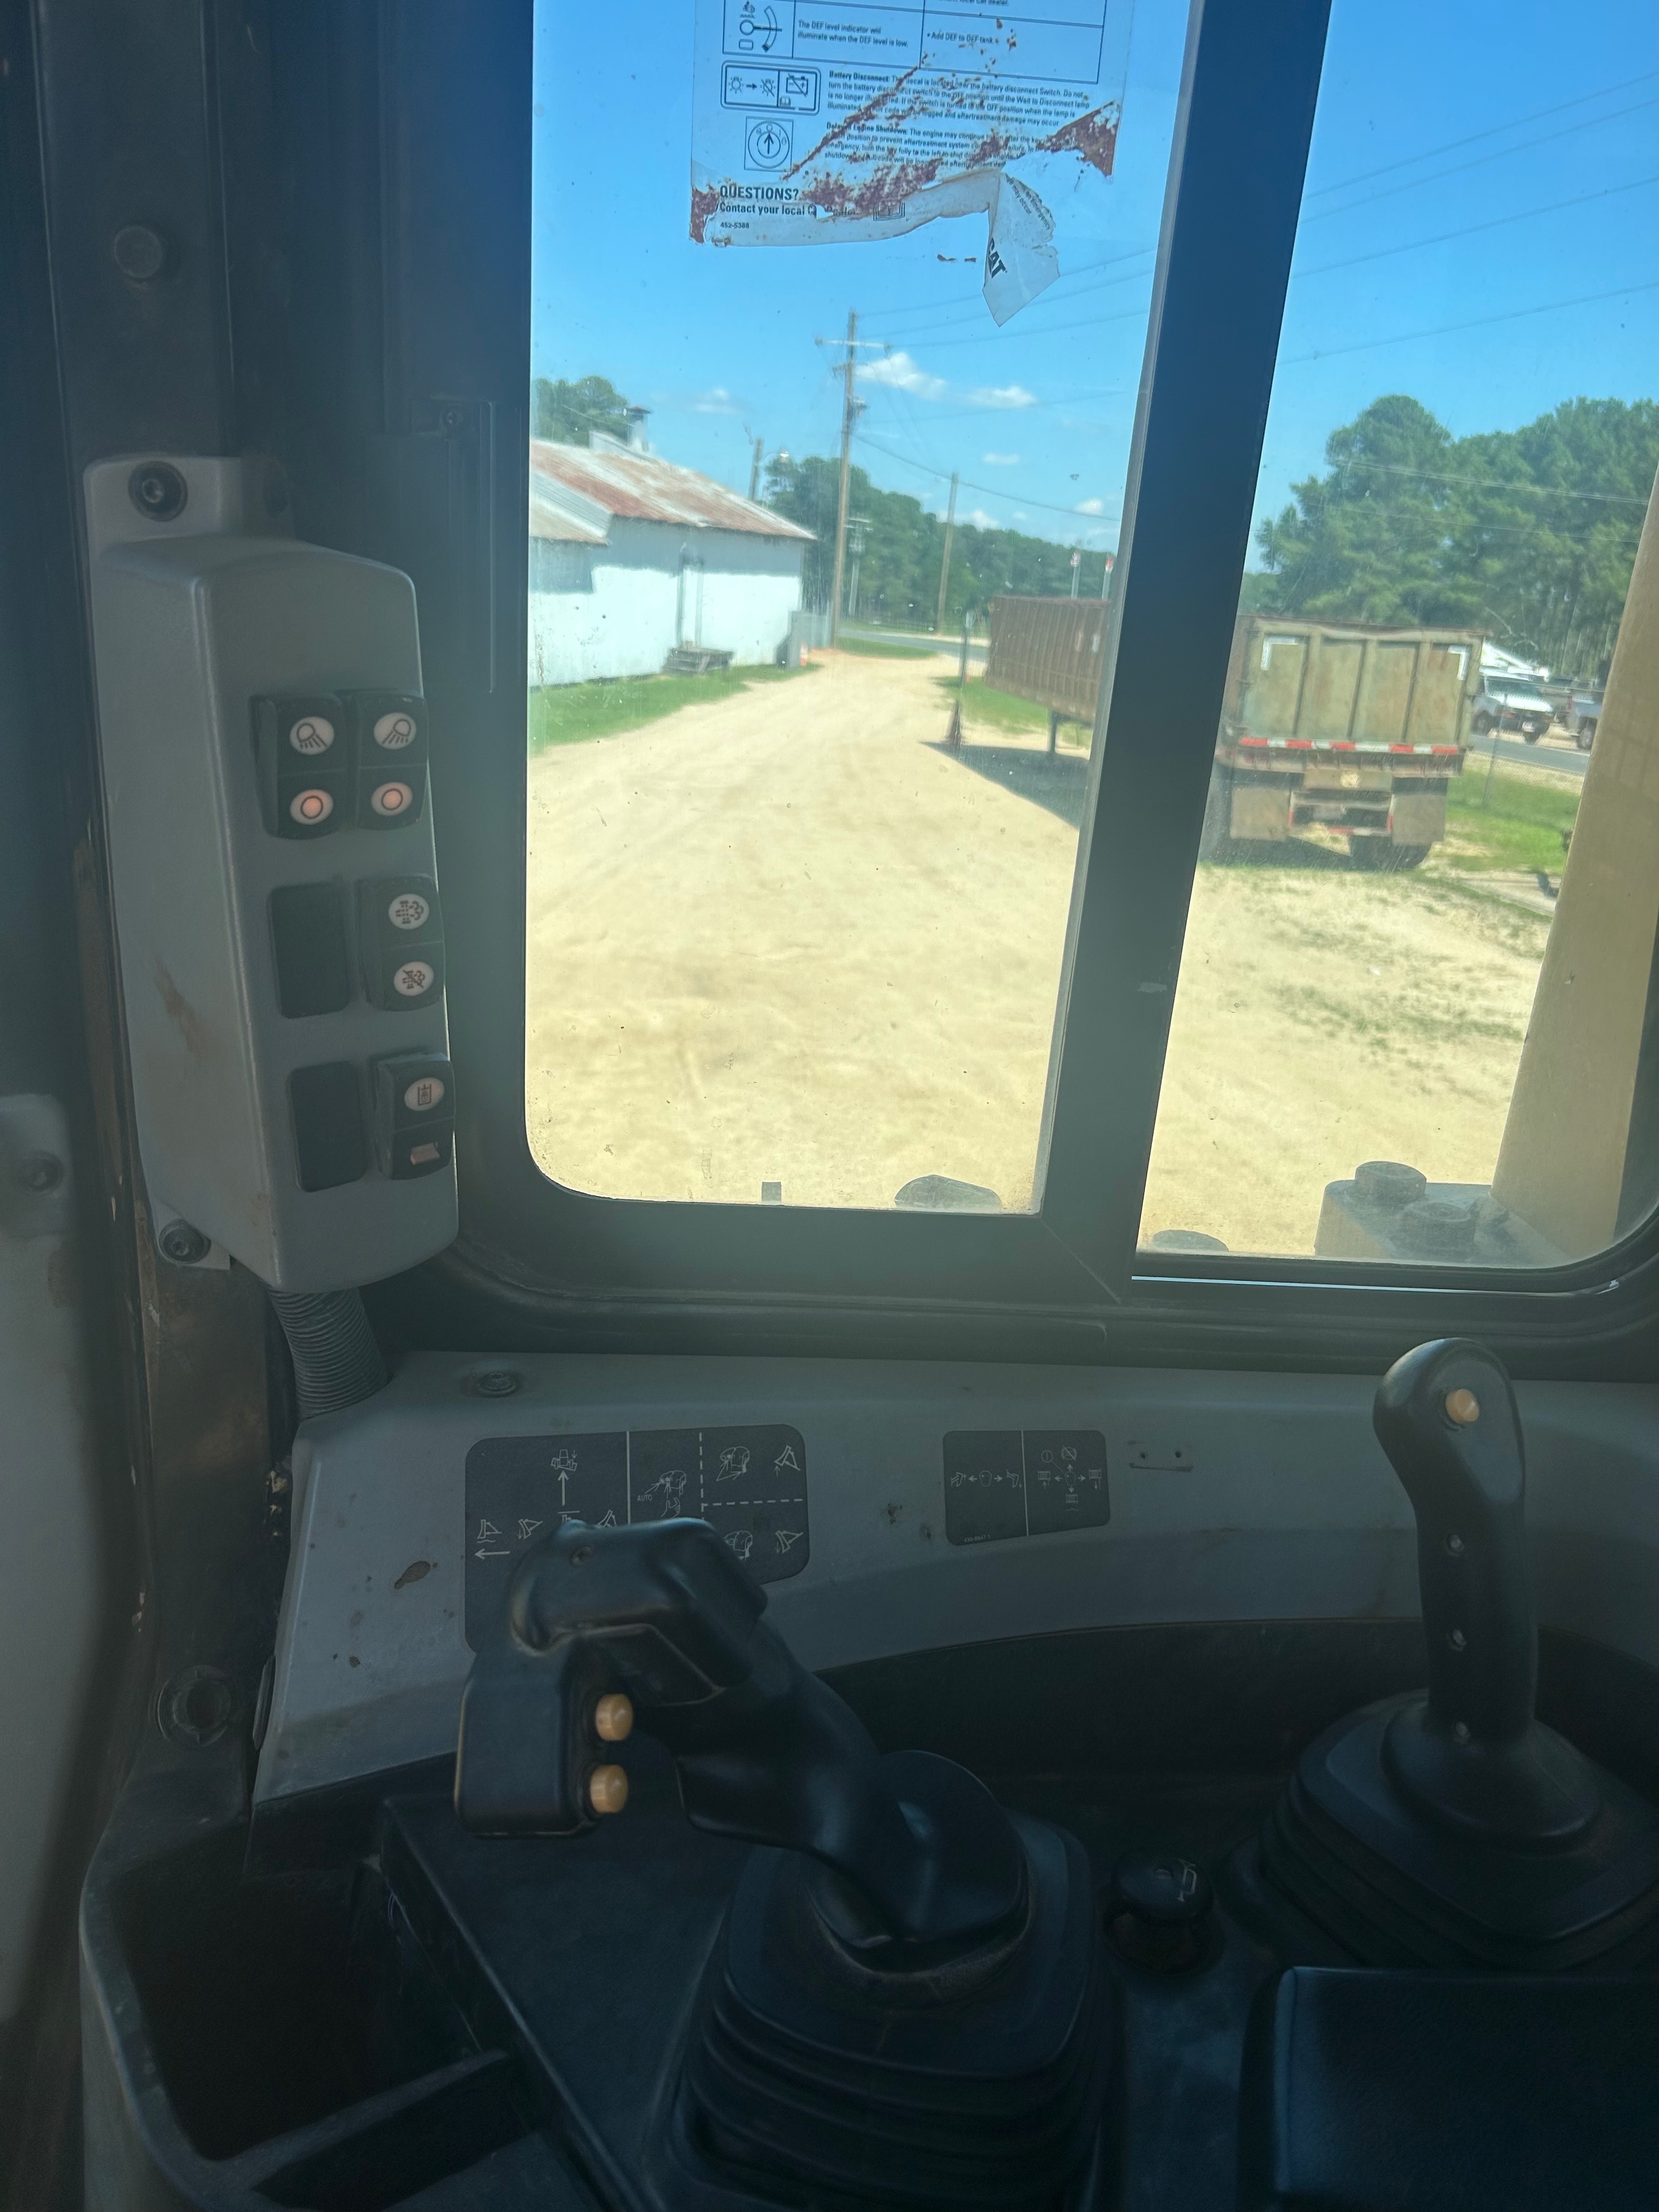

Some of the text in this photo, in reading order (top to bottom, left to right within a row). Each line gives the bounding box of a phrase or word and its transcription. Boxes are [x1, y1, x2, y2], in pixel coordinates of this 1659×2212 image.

[798, 20, 882, 34] The DEF level indicator will
[798, 30, 827, 40] illuminate
[830, 33, 847, 42] when
[848, 34, 858, 43] the
[860, 35, 872, 44] DEF
[873, 36, 888, 46] level
[889, 38, 894, 46] is
[931, 31, 944, 40] Add
[945, 32, 957, 41] DEF
[959, 33, 965, 42] to
[967, 33, 979, 43] DEF
[830, 70, 852, 81] Battery
[982, 83, 1003, 93] battery
[1005, 85, 1038, 94] disconnect
[1063, 89, 1071, 97] Do
[828, 81, 841, 89] turn
[843, 82, 853, 91] the
[854, 83, 876, 93] battery
[912, 88, 933, 97] switch
[966, 92, 990, 101] position
[991, 95, 1004, 103] until
[1017, 95, 1030, 104] Wait
[1040, 97, 1073, 107] Disconnect
[1075, 99, 1090, 109] lamp
[844, 92, 864, 103] longer
[907, 97, 917, 105] the
[919, 98, 939, 108] switch
[946, 101, 967, 110] turned
[987, 103, 998, 111] OFF
[1000, 105, 1023, 114] position
[1025, 107, 1041, 115] when
[1054, 109, 1069, 119] lamp
[944, 111, 956, 119] and
[957, 111, 1001, 122] aftertreatment
[1001, 114, 1026, 124] damage
[1027, 117, 1040, 127] may
[910, 127, 921, 136] The
[923, 130, 943, 139] engine
[944, 132, 957, 140] may
[887, 146, 898, 156] ky
[898, 146, 911, 156] fully
[920, 148, 930, 156] the
[904, 138, 947, 148] aftertreatment
[720, 185, 799, 201] QUESTIONS?
[720, 202, 755, 213] Contact
[758, 206, 779, 216] your
[782, 206, 805, 216] local
[1030, 198, 1050, 230] emergency
